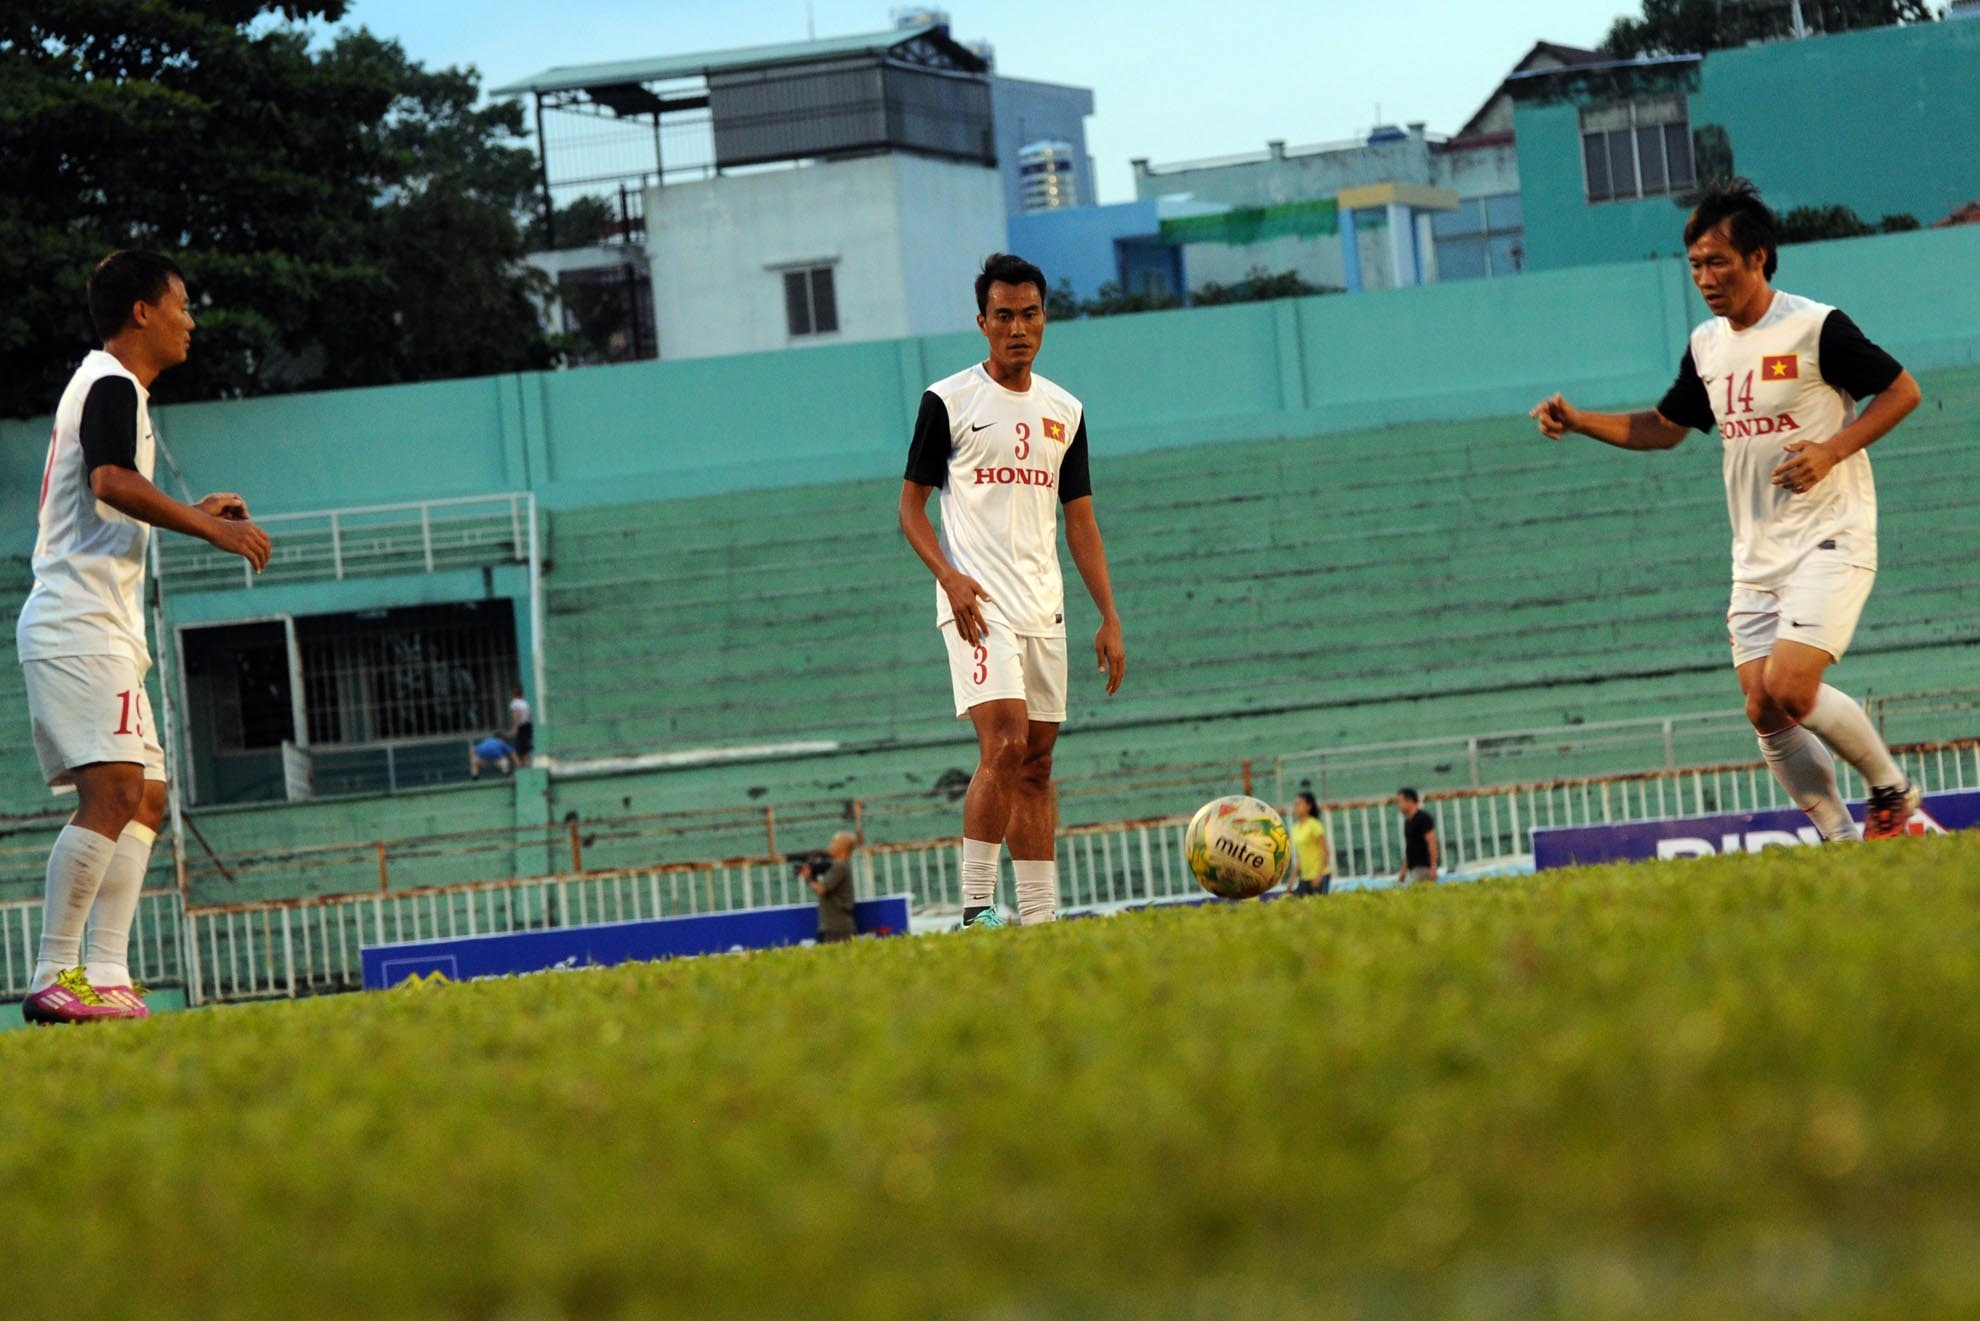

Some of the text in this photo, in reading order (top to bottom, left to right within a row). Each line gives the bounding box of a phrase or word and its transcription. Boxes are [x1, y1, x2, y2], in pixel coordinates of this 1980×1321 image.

[1724, 369, 1754, 416] 14
[1015, 422, 1030, 461] 3
[973, 645, 988, 685] 3
[1215, 836, 1264, 868] mitre
